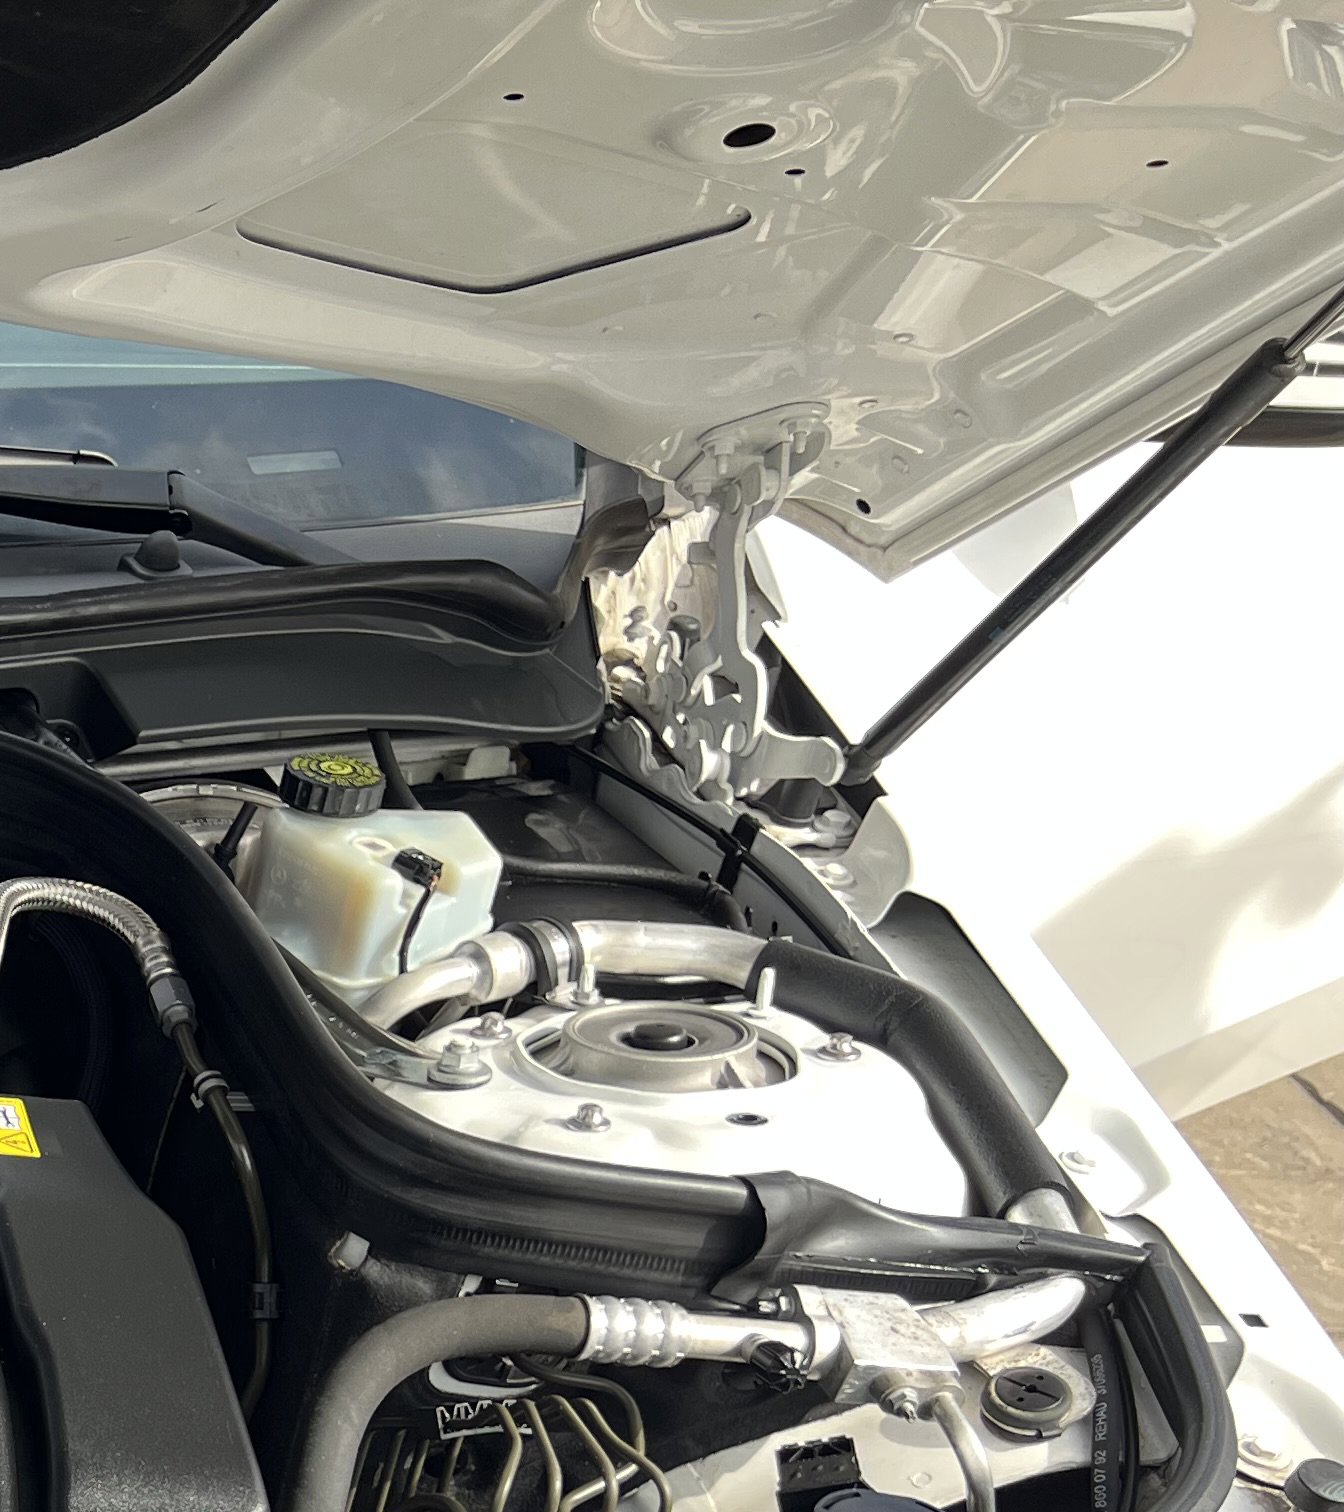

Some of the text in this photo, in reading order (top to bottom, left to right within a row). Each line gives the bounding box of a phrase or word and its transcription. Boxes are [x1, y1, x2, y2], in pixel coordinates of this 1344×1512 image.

[1094, 1402, 1107, 1441] REHAU
[1094, 1450, 1106, 1465] 92
[1094, 1469, 1106, 1483] 07
